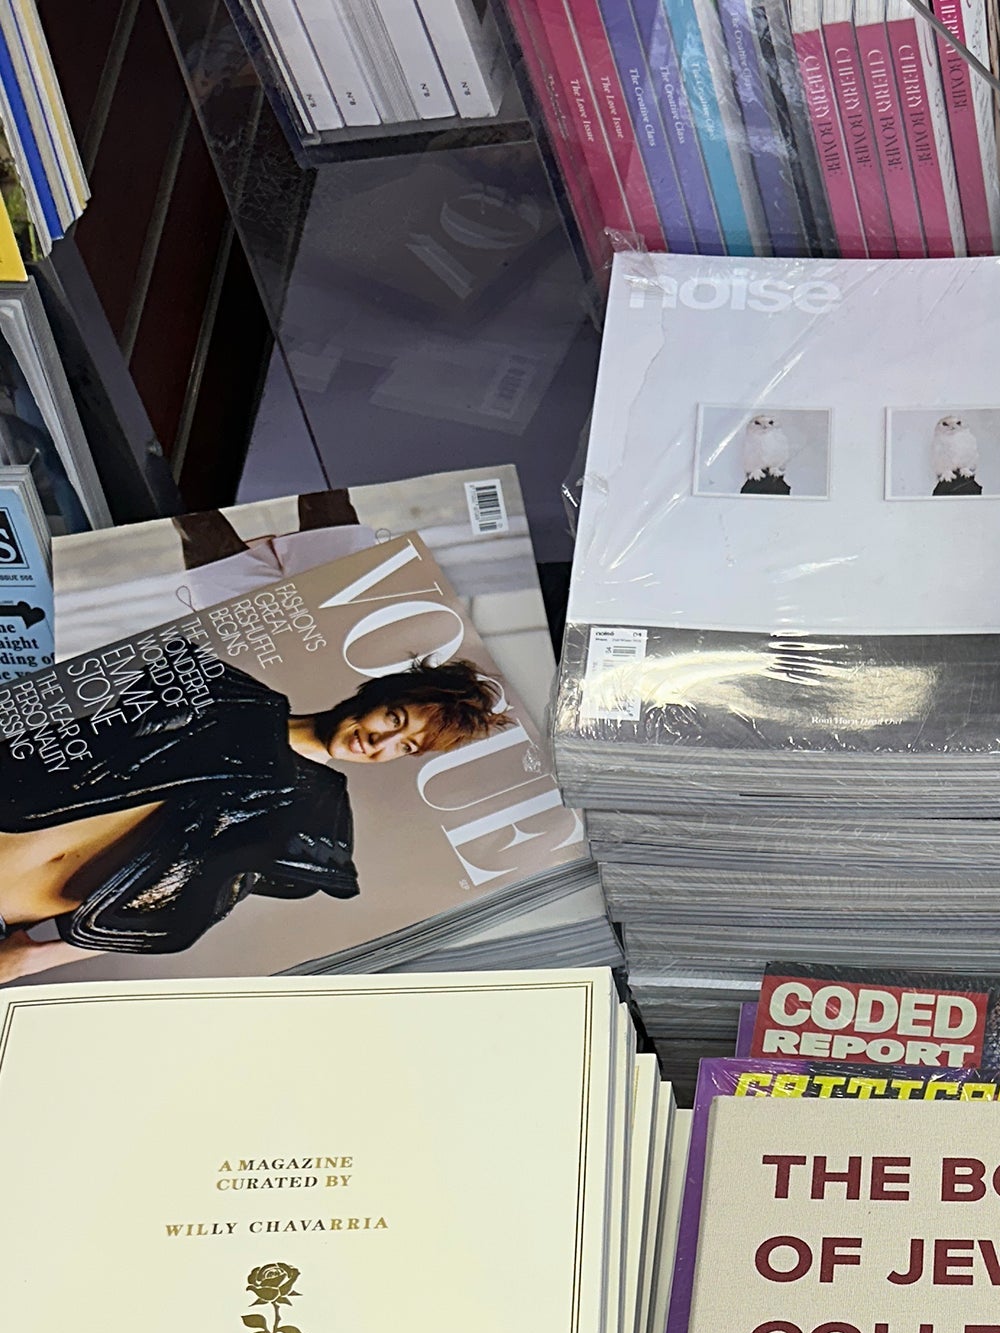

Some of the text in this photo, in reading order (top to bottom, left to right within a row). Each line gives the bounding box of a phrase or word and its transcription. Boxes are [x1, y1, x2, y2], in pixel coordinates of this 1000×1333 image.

[645, 124, 656, 147] Class
[804, 55, 842, 173] CHERRY BOMBE
[835, 47, 872, 166] CHERRY BOMBE
[867, 49, 902, 168] CHERRY BOMBE
[899, 44, 933, 164] CHERRY BOMBE
[182, 617, 208, 645] THE
[209, 607, 249, 657] BEGINS
[231, 599, 283, 669] RESHUFFLE
[254, 592, 294, 635] GREAT
[275, 583, 327, 652] FASHION'S
[67, 657, 128, 735] STONE
[101, 645, 158, 722] EMMA
[160, 626, 215, 715] WONDERFUL
[162, 687, 188, 708] OF
[0, 689, 34, 760] DRESSING
[13, 681, 70, 773] PERSONALITY
[36, 671, 93, 760] THE YEAR OF
[318, 538, 585, 887] VOUE
[769, 981, 977, 1040] CODED
[762, 1029, 975, 1068] REPORT
[216, 1175, 352, 1191] CURATED BY
[218, 1156, 353, 1172] A MAGAZINE
[762, 1155, 911, 1201] THE
[165, 1217, 389, 1237] WILLY CHAVARRIA
[755, 1236, 863, 1284] OF
